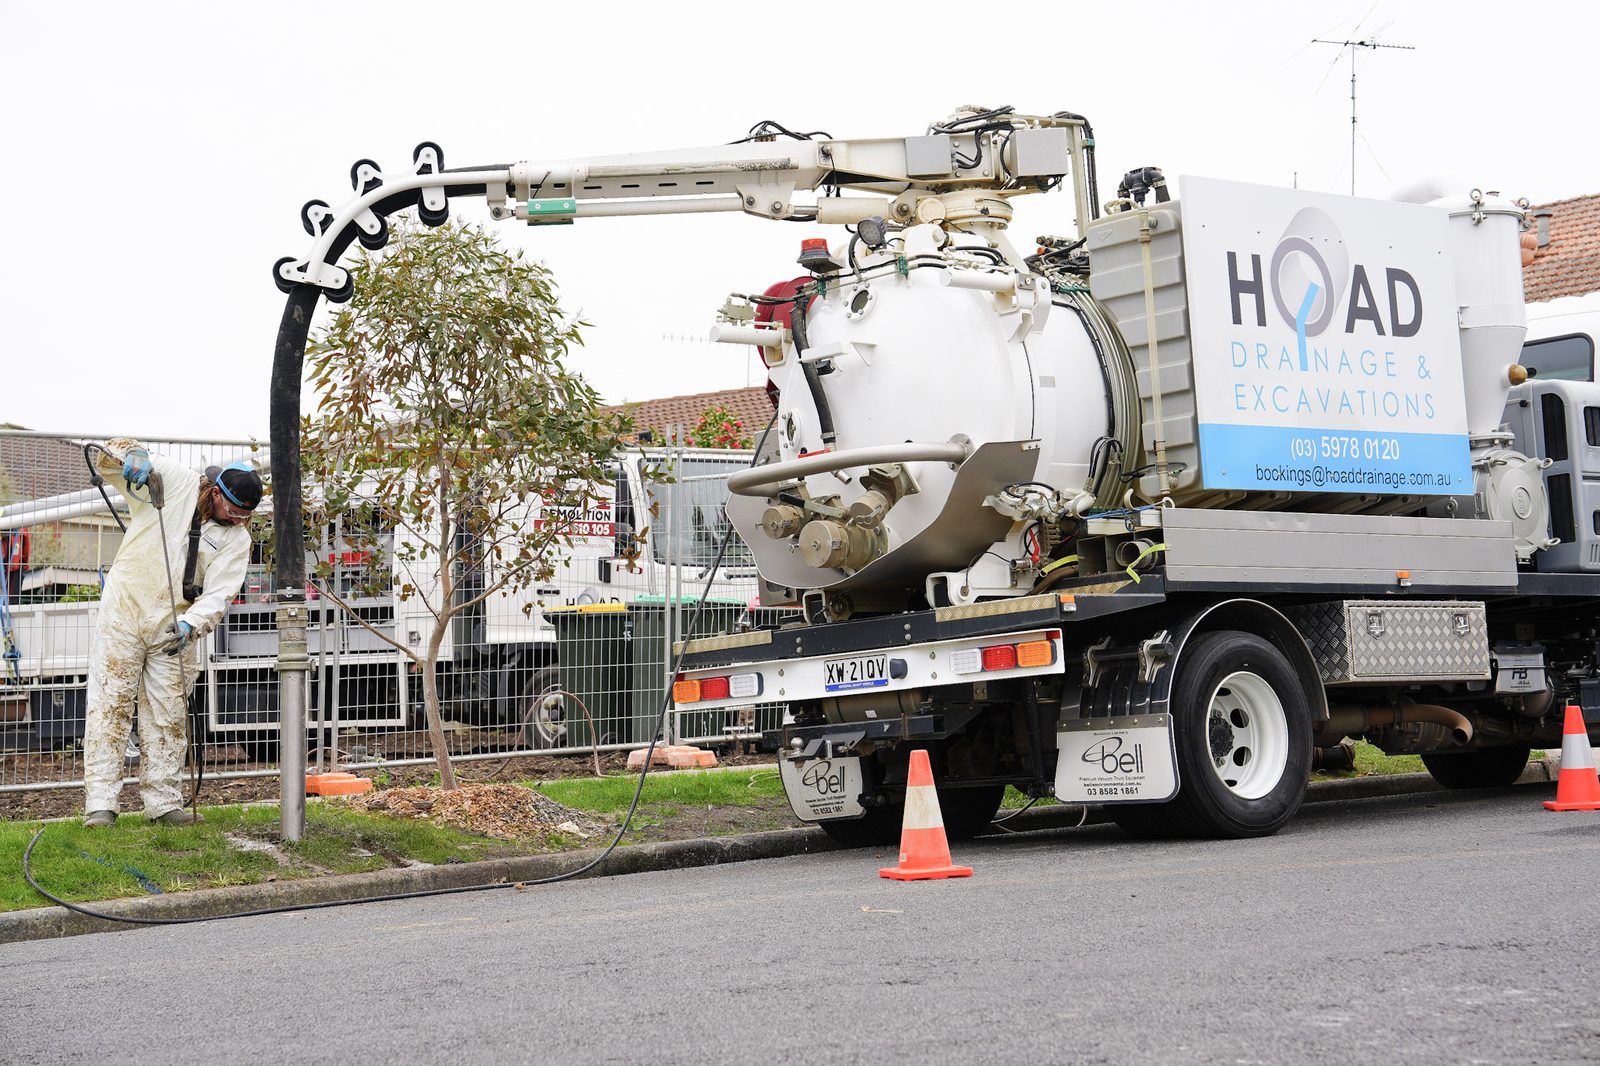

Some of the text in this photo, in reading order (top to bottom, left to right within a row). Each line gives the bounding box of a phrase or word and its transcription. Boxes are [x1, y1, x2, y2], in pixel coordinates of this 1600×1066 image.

[1227, 237, 1423, 338] HOAD
[1231, 341, 1432, 379] DRAINAGE &
[1235, 383, 1435, 419] EXCAVATIONS
[1291, 436, 1400, 462] (03) 5978 0120
[1256, 464, 1451, 489] bookings@hoaddrainage.com.au
[541, 508, 611, 521] EMOLTION
[572, 522, 590, 535] 10
[591, 523, 610, 536] 105
[1087, 786, 1139, 796] 03 8582 1861
